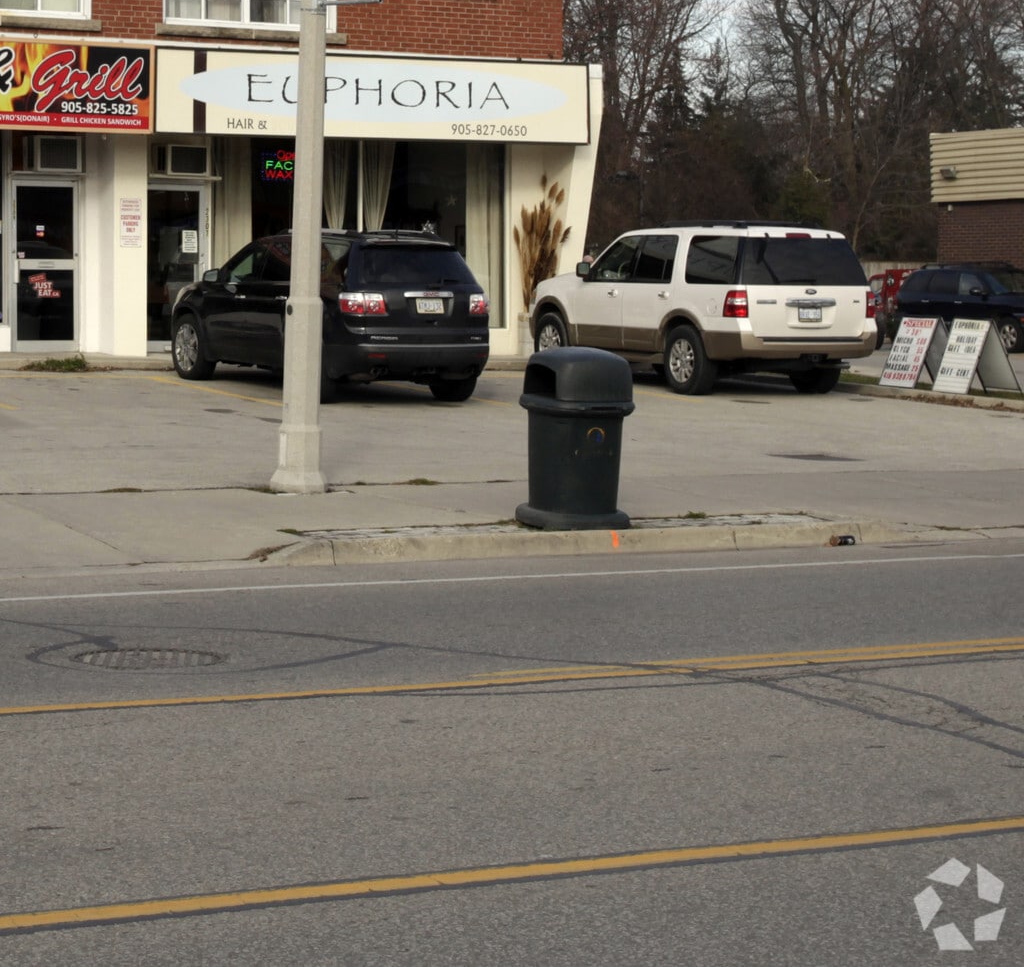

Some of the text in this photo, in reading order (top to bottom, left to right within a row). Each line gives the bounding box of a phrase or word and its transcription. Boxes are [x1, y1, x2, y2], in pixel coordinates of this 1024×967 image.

[32, 49, 145, 113] Grill
[61, 100, 139, 116] 905-825-5825
[61, 116, 142, 126] GRILL CHICKEN SANDWICH
[227, 118, 268, 130] HAIR &
[451, 124, 528, 136] 905-827-0650
[34, 282, 53, 290] JUST
